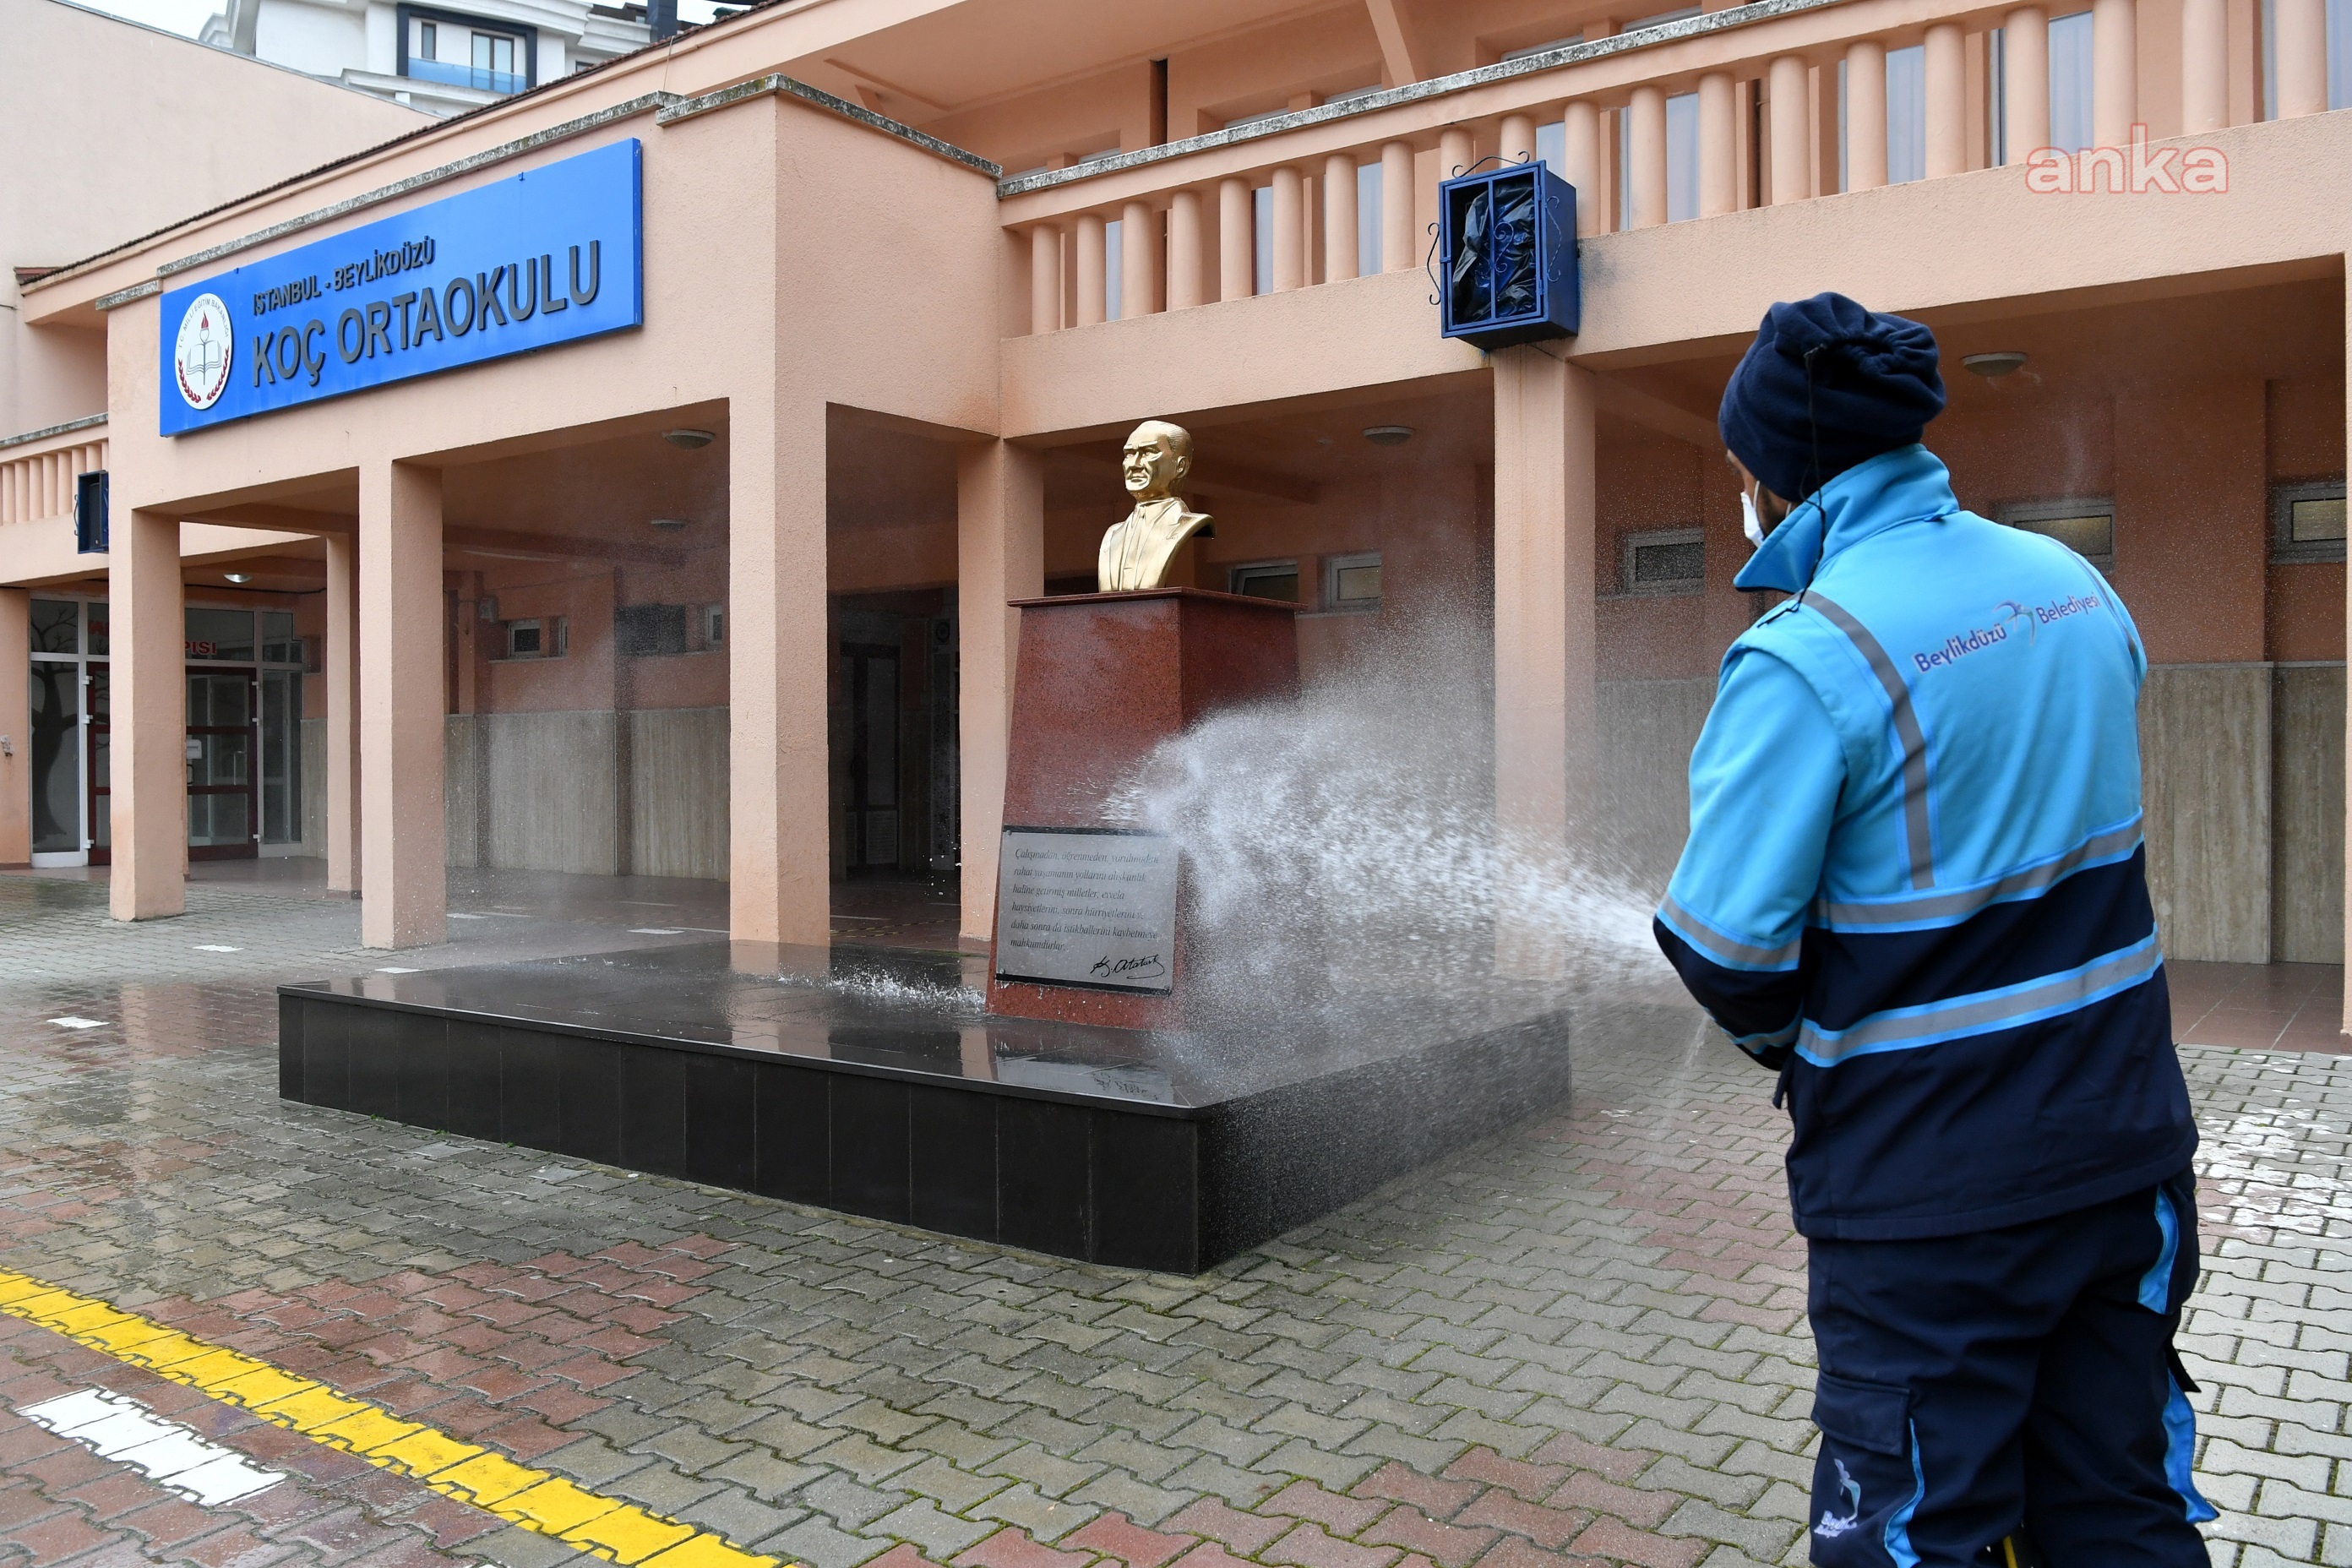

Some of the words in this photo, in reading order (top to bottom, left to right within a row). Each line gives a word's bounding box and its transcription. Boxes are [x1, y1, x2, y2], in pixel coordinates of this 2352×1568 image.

[333, 235, 436, 291] BEYLİKDÜZÜ
[253, 318, 327, 388] KOÇ
[337, 240, 600, 363] ORTAOKULU
[1914, 623, 2008, 673] Beylikdüzü
[2035, 591, 2102, 624] Belediyesi
[1014, 867, 1032, 876] rahat
[1010, 920, 1029, 929] daha
[1030, 923, 1051, 931] sonra
[1061, 907, 1082, 916] sonra
